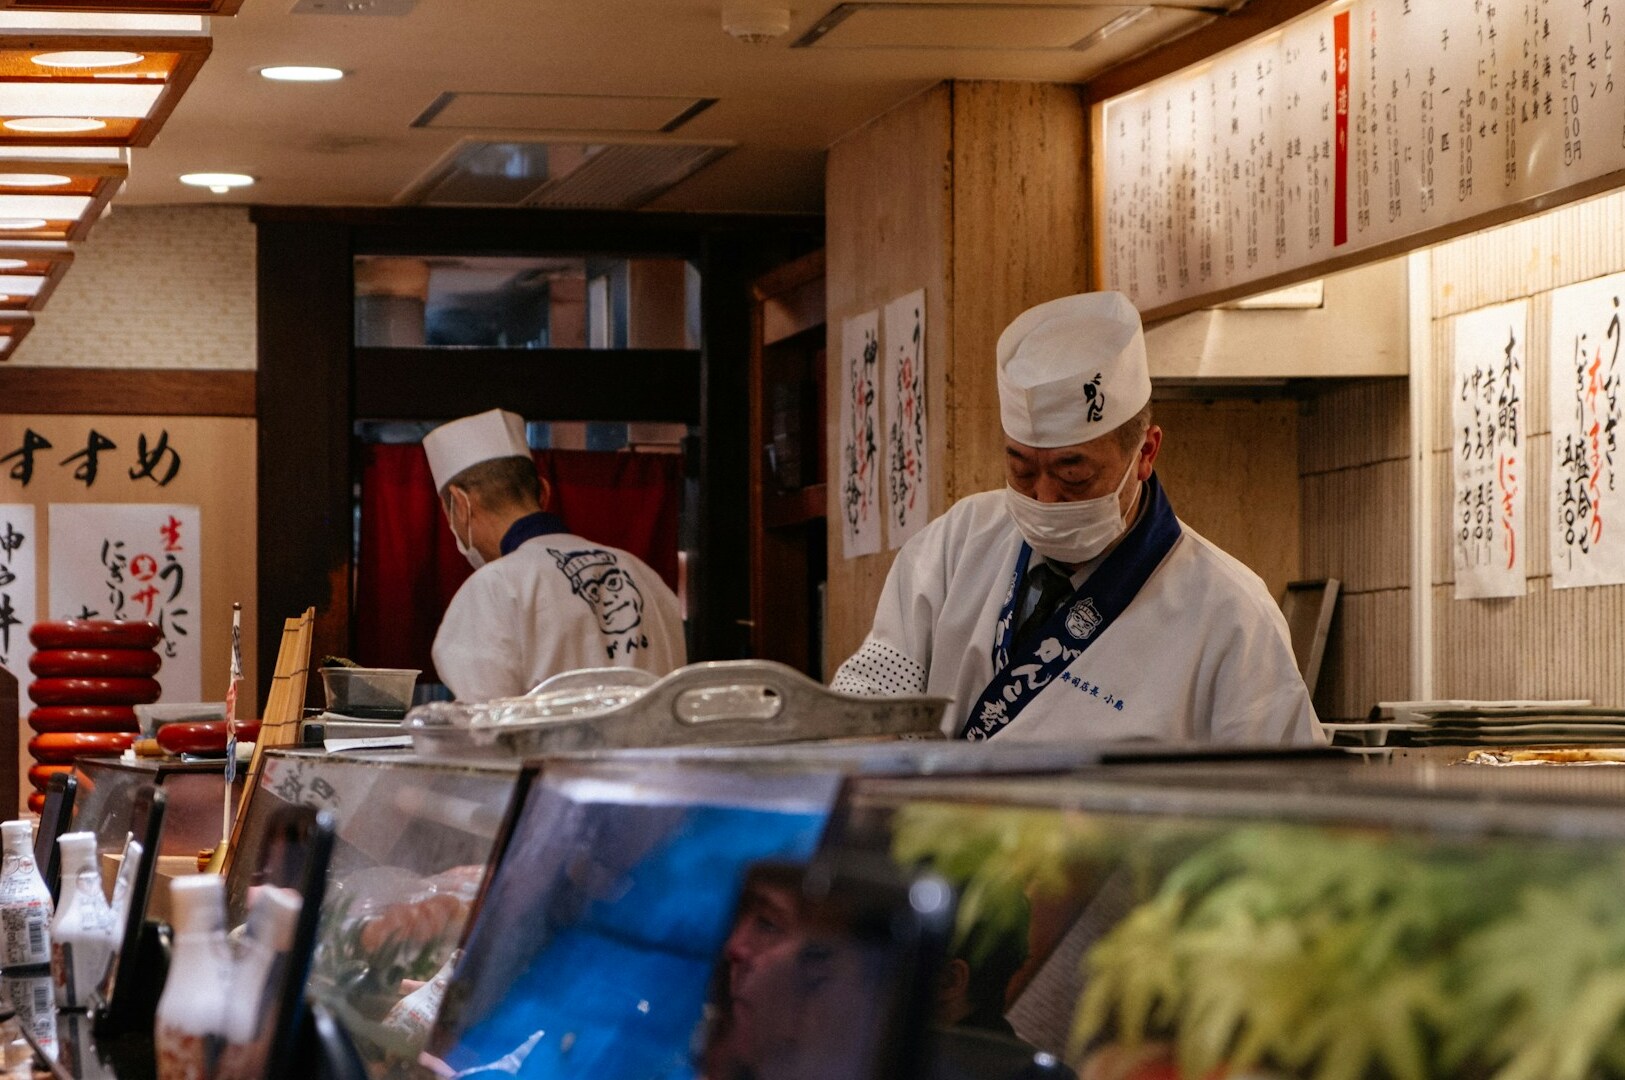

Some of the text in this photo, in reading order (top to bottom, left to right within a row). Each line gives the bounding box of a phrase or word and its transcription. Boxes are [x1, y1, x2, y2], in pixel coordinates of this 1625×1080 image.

[1337, 48, 1348, 153] お造り
[1541, 0, 1552, 115] 車海老
[0, 428, 181, 487] すすめ
[1586, 344, 1604, 544] 本まぐろ
[1603, 296, 1621, 491] うなぎと
[0, 522, 25, 664] 神戸牛
[101, 538, 127, 620] にぎり
[159, 515, 188, 658] 生うにと
